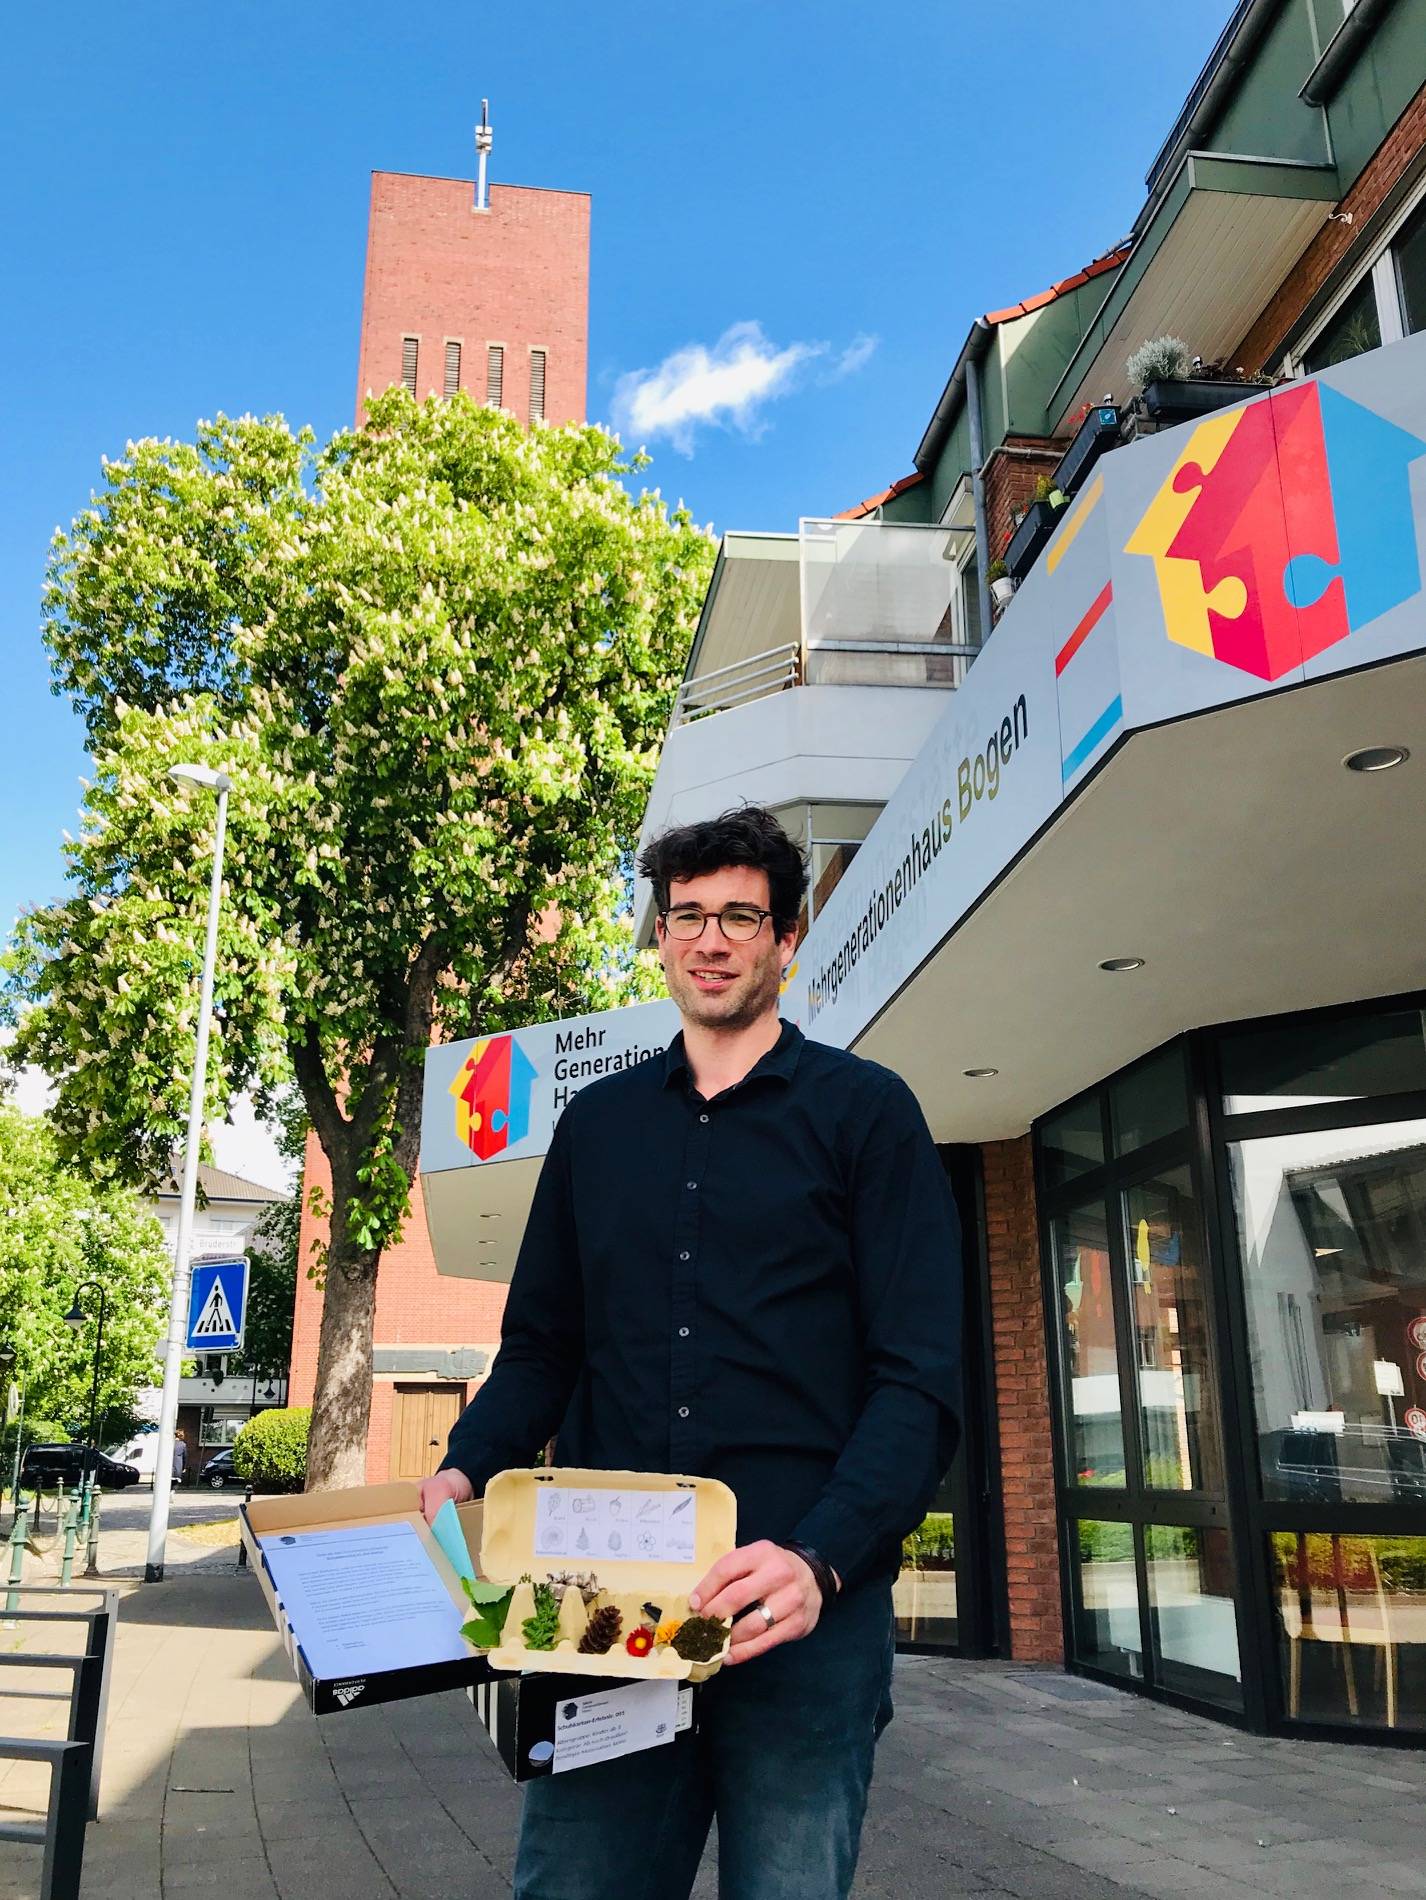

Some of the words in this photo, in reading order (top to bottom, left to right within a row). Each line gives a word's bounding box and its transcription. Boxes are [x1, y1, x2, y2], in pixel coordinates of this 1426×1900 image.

[808, 799, 952, 1024] Mehrgenerationenhaus
[957, 694, 1028, 824] Bogen
[555, 1027, 606, 1054] Mehr
